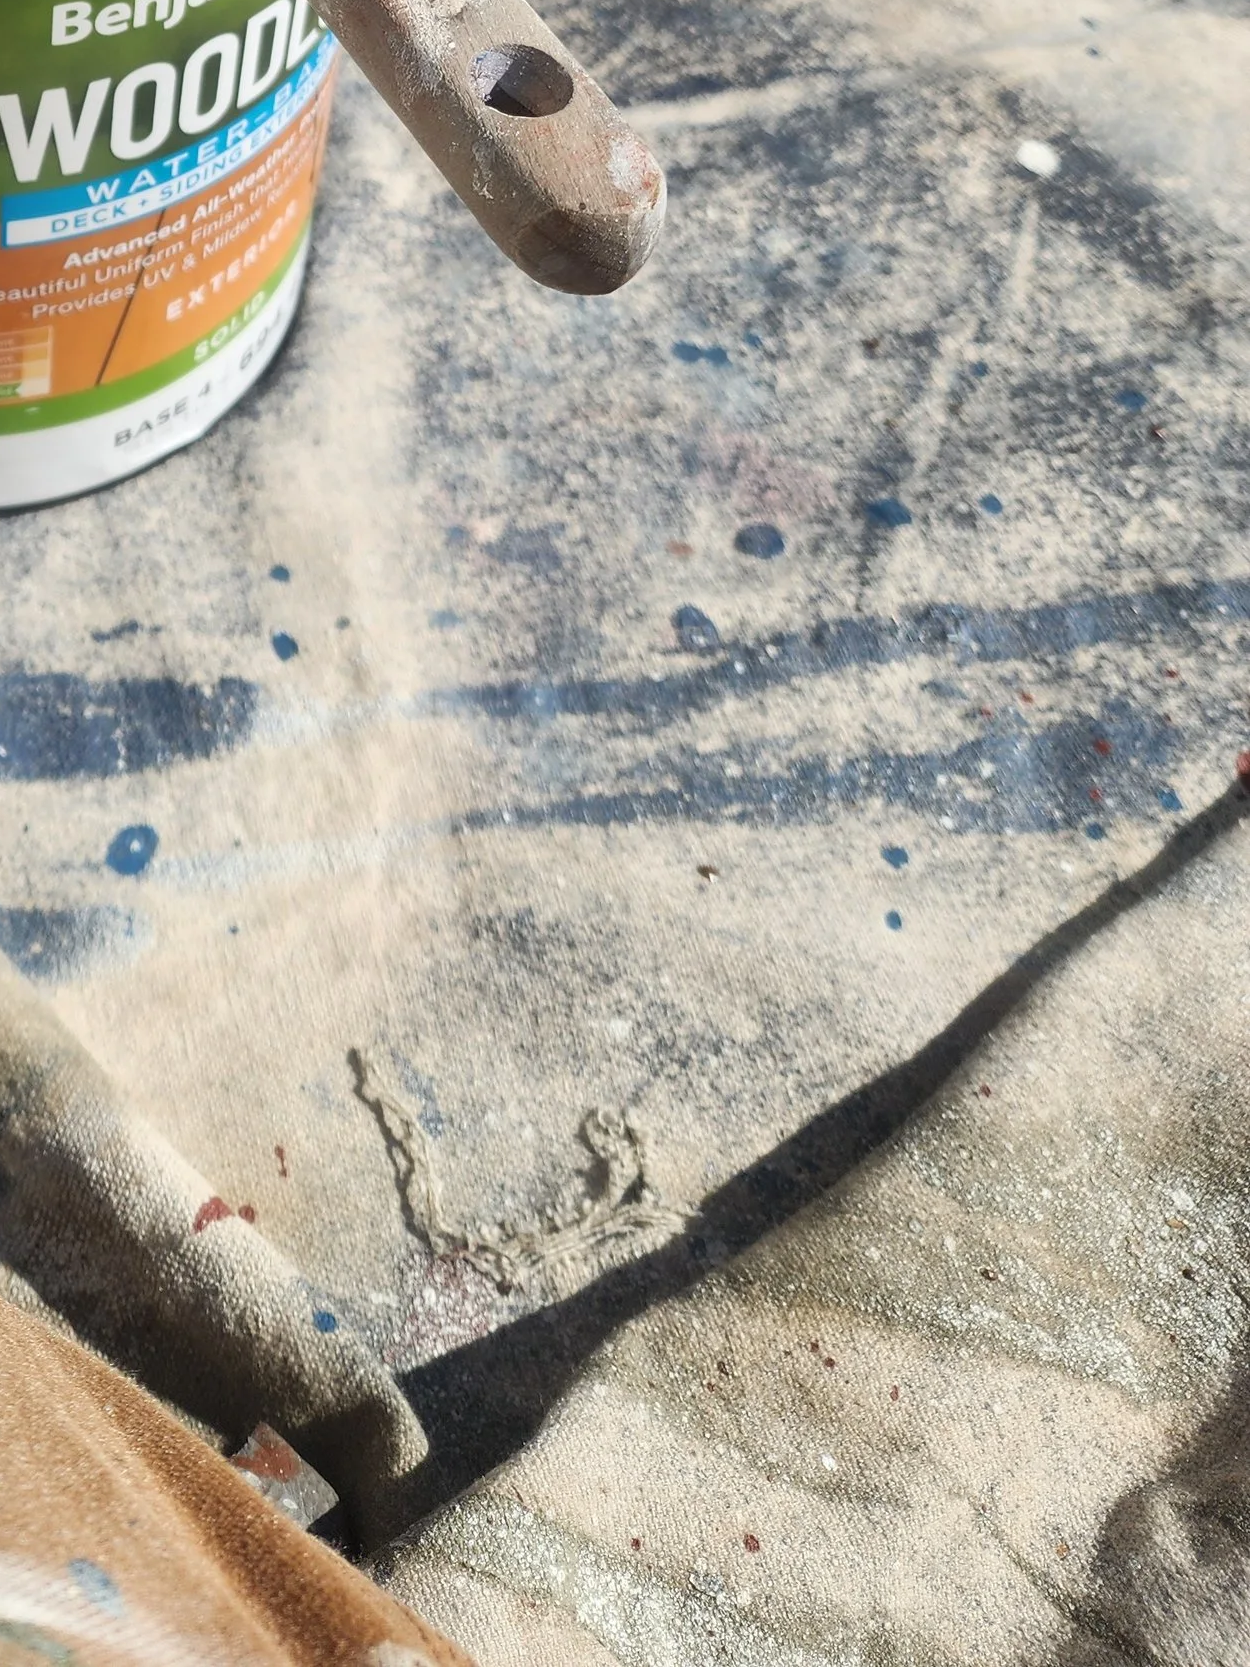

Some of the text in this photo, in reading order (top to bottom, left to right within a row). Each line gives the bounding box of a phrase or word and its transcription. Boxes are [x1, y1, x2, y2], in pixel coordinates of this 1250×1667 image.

[51, 200, 127, 234] DECK
[159, 148, 242, 201] SIDING
[31, 211, 261, 320] Provides UV & Mildew
[63, 219, 186, 269] Advanced
[94, 241, 185, 285] Uniform
[191, 202, 244, 245] Finish
[194, 290, 266, 363] SOLID
[114, 400, 188, 447] BASE
[197, 382, 212, 401] 4
